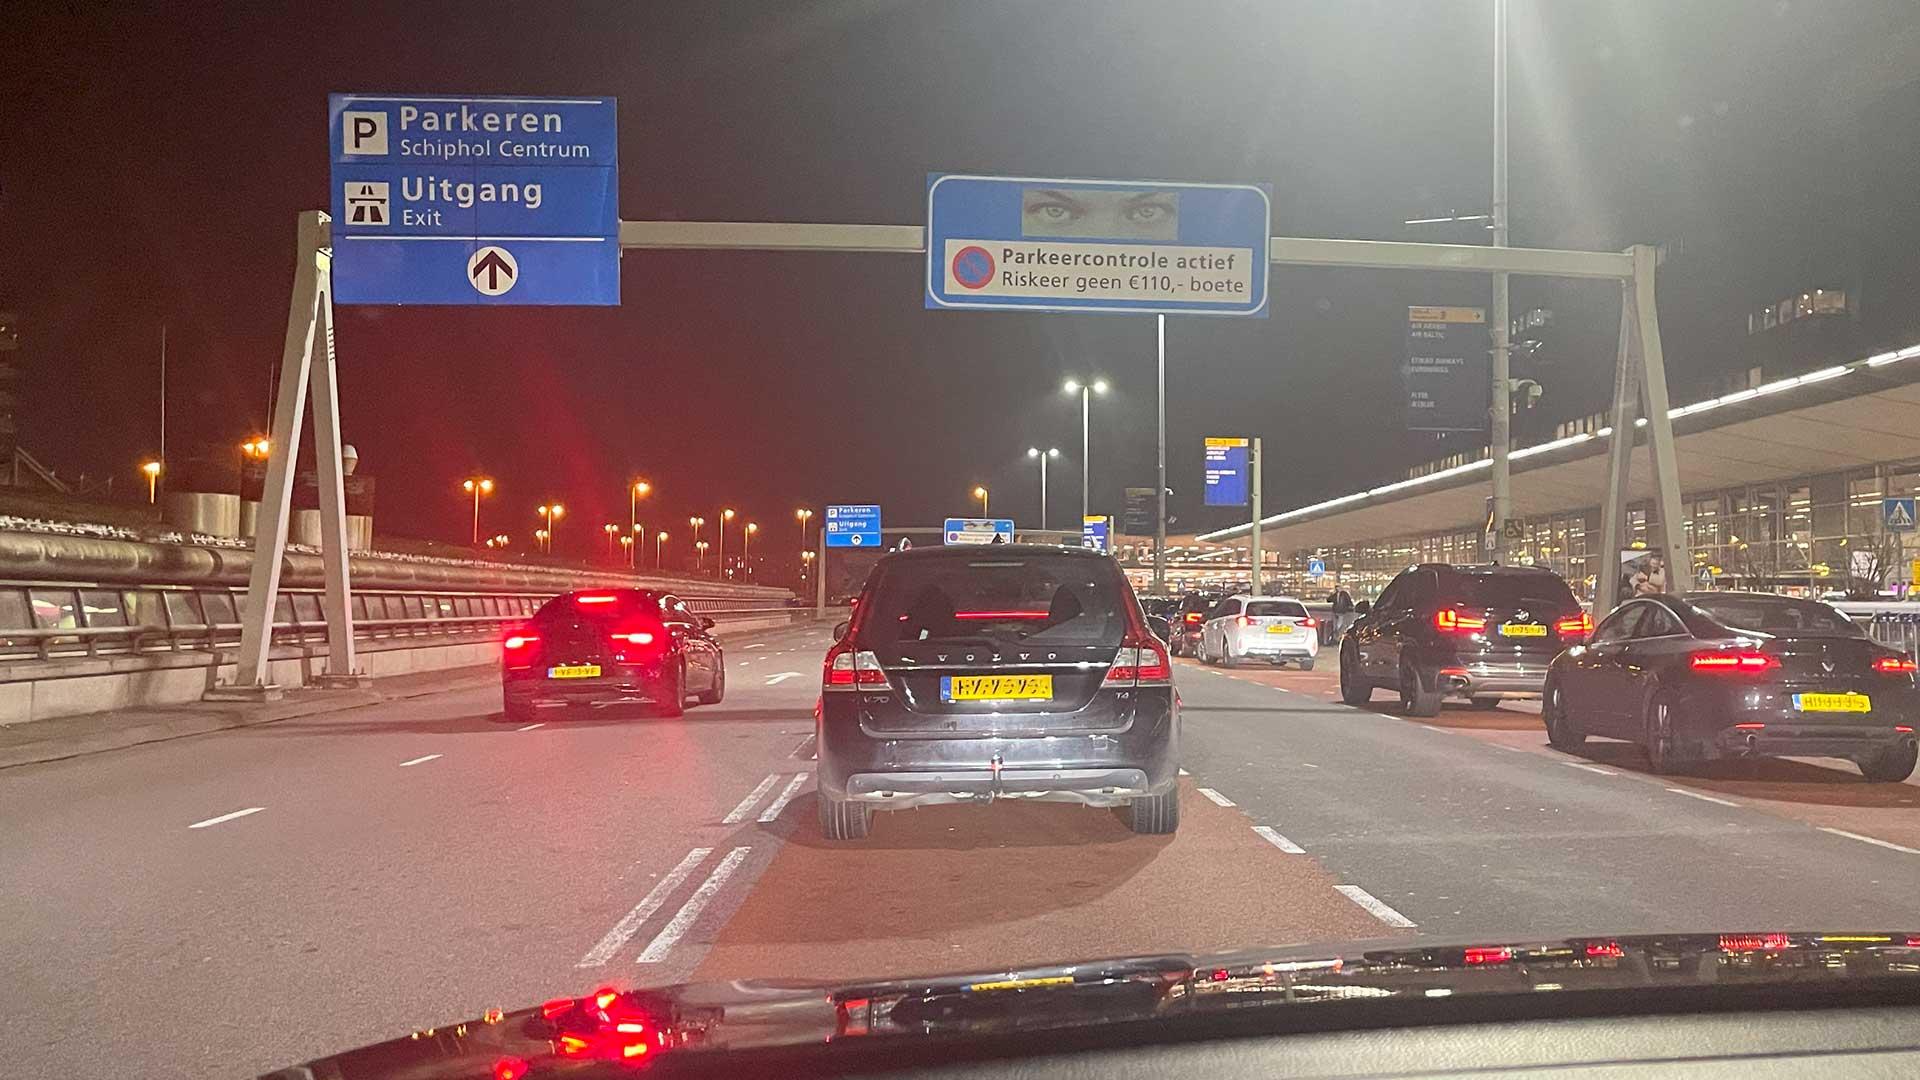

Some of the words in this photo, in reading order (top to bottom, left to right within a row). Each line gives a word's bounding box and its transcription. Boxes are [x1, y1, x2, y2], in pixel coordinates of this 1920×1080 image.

[400, 105, 562, 133] Parkeren
[353, 117, 377, 149] P
[401, 139, 491, 160] Schiphol
[499, 140, 590, 158] Centrum
[401, 176, 542, 209] Uitgang
[403, 209, 442, 227] Exit
[1002, 248, 1169, 269] Parkeercontrole
[1176, 253, 1235, 270] actief
[1002, 271, 1069, 288] Riskeer
[1076, 275, 1122, 292] geen
[1129, 275, 1184, 293] €110,-
[1190, 276, 1244, 293] boete
[937, 653, 1057, 662] VOLVO
